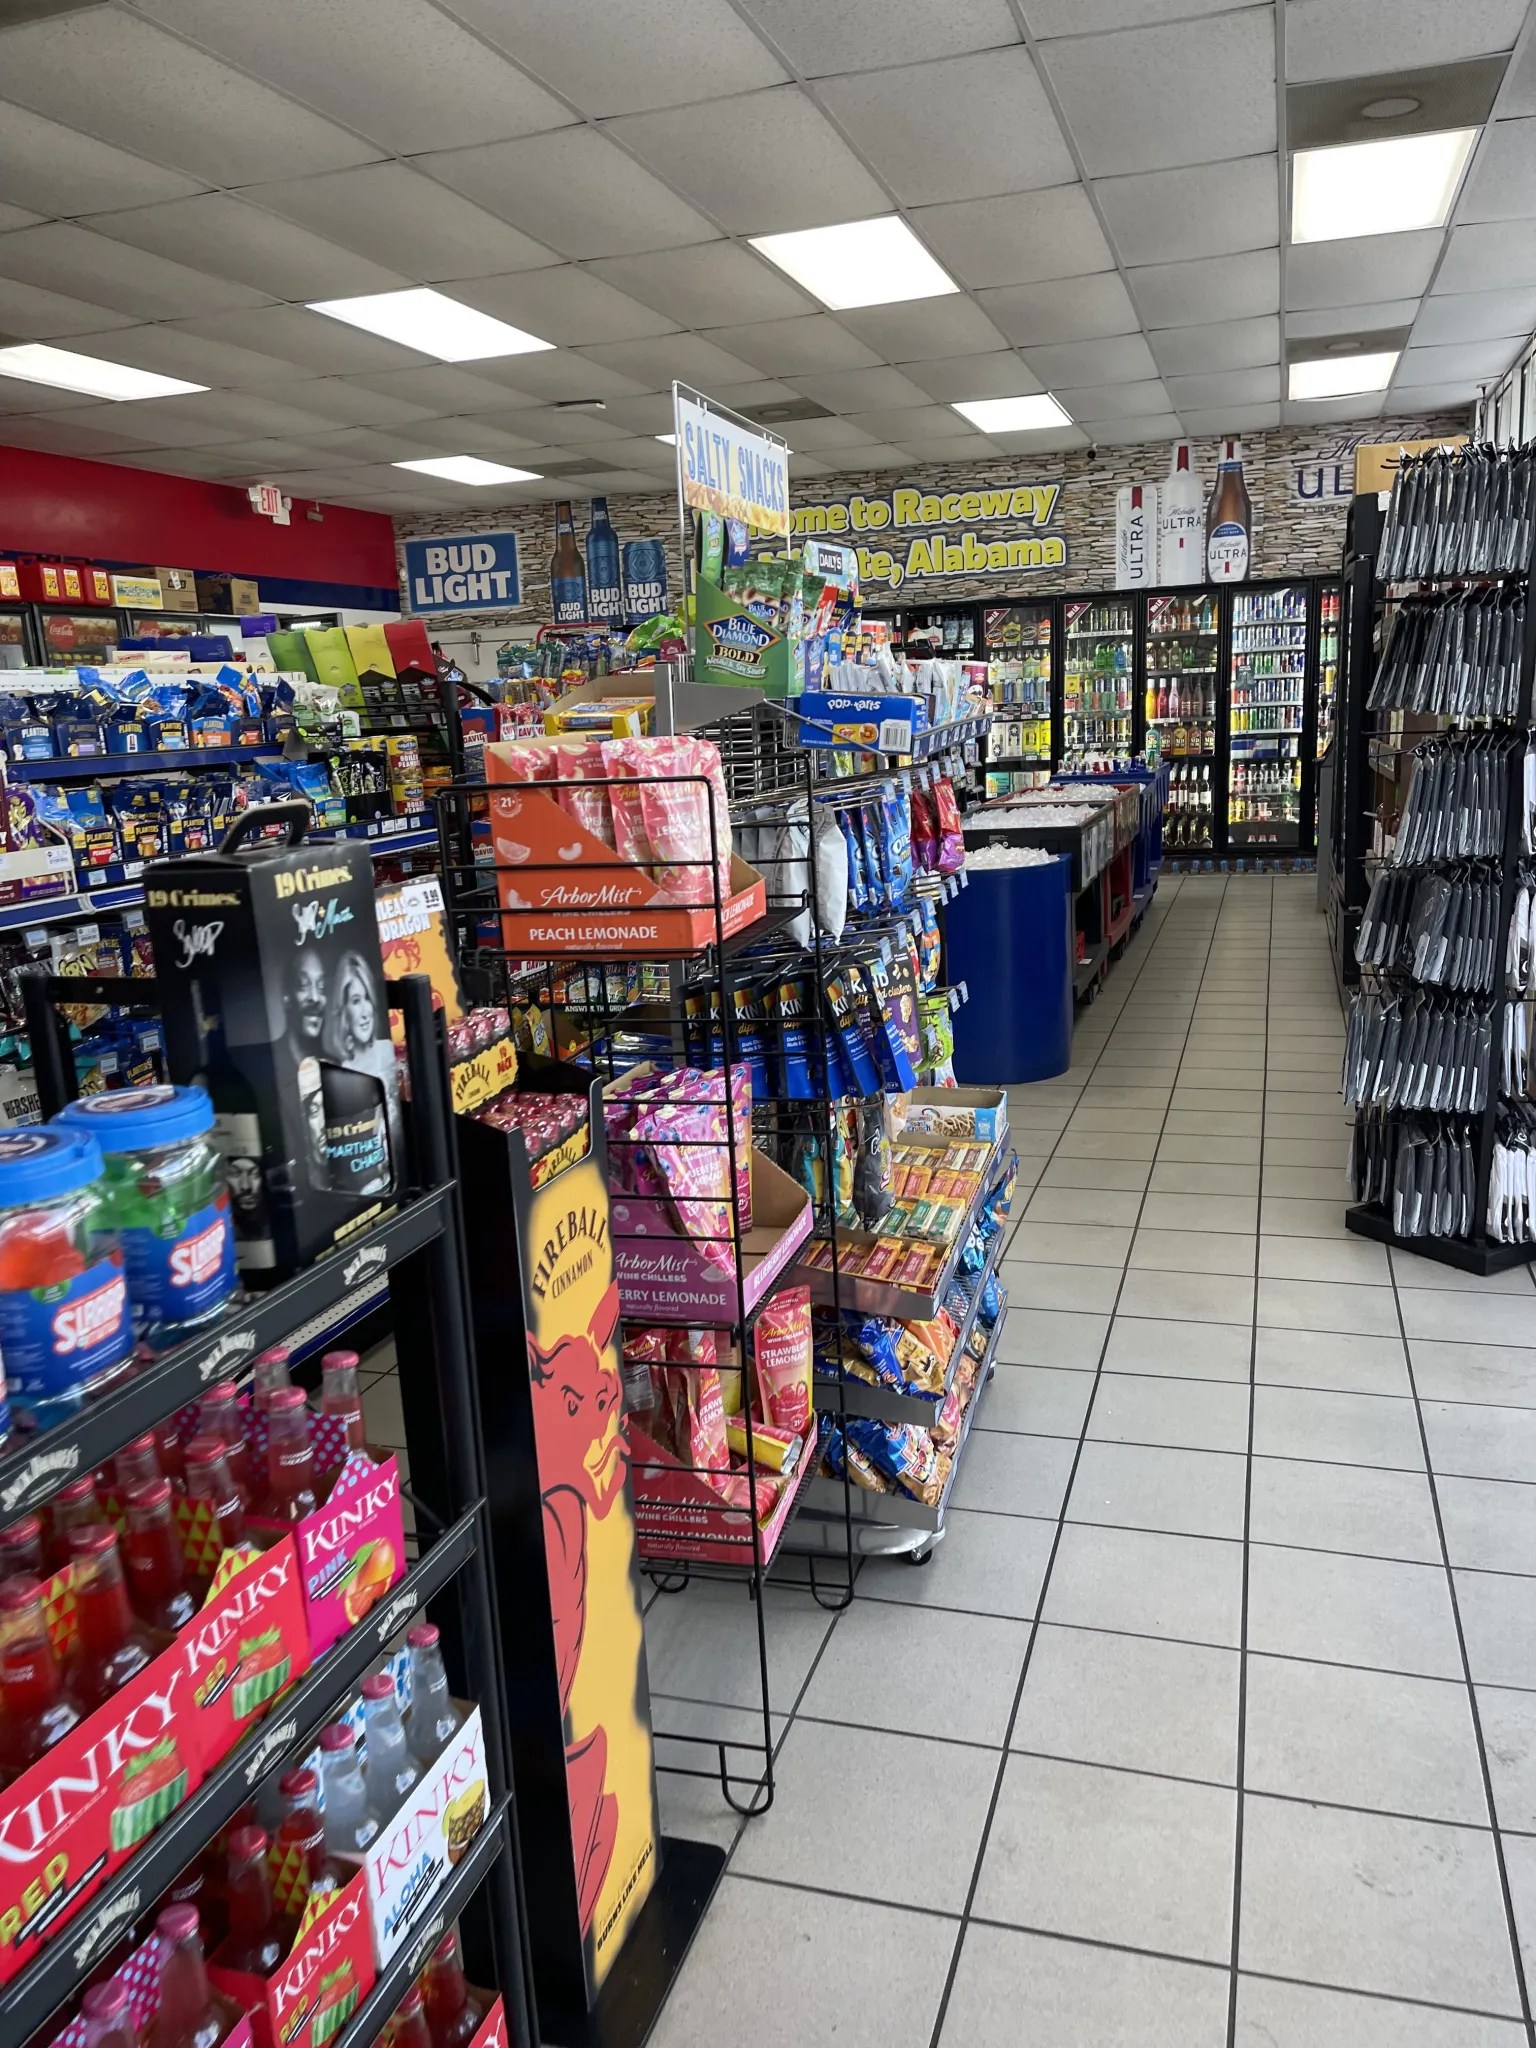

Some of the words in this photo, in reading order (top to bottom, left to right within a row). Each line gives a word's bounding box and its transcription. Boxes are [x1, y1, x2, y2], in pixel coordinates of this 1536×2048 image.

[685, 421, 731, 494] SALTY
[738, 446, 785, 513] SNACKS
[1297, 466, 1352, 499] UL
[260, 488, 279, 514] EXIT
[853, 499, 888, 526] to
[896, 487, 1057, 524] Raceway
[1163, 516, 1202, 529] ULTRA
[426, 543, 496, 576] BUD
[909, 534, 1063, 575] Alabama
[1131, 515, 1144, 580] ULTRA
[1209, 548, 1247, 560] ULTRA
[416, 571, 511, 605] LIGHT
[591, 588, 620, 602] BUD
[627, 582, 663, 599] BUD
[558, 610, 585, 621] LIGHT
[560, 602, 582, 612] BUD
[588, 600, 624, 617] LIGHT
[625, 597, 668, 614] LIGHT
[712, 625, 770, 647] DIAMOND
[729, 617, 757, 635] BLUE
[719, 646, 755, 663] BOLD
[148, 890, 164, 907] 19
[275, 872, 296, 899] 19
[381, 913, 432, 943] DRAGON
[530, 928, 575, 941] PEACH
[578, 925, 658, 940] LEMONADE
[780, 999, 802, 1017] KIN
[455, 1063, 491, 1101] FIREBALL
[532, 1205, 608, 1300] FIREBALL
[551, 1248, 594, 1299] CINNAMON
[641, 1272, 688, 1283] CHILLERS
[618, 1288, 649, 1301] ERRY
[652, 1291, 727, 1306] LEMONADE
[303, 1470, 399, 1564] KINKY
[662, 1513, 709, 1525] CHILLERS
[307, 1548, 348, 1595] PINK
[184, 1552, 294, 1679] KINKY
[192, 1656, 228, 1708] RED
[372, 1727, 480, 1901] KINKY
[622, 1872, 638, 1905] LIKE
[637, 1842, 654, 1875] HELL
[0, 1852, 70, 1946] RED
[383, 1852, 433, 1941] ALOHA
[273, 1887, 364, 2019] KINKY
[280, 1993, 308, 2046] RED
